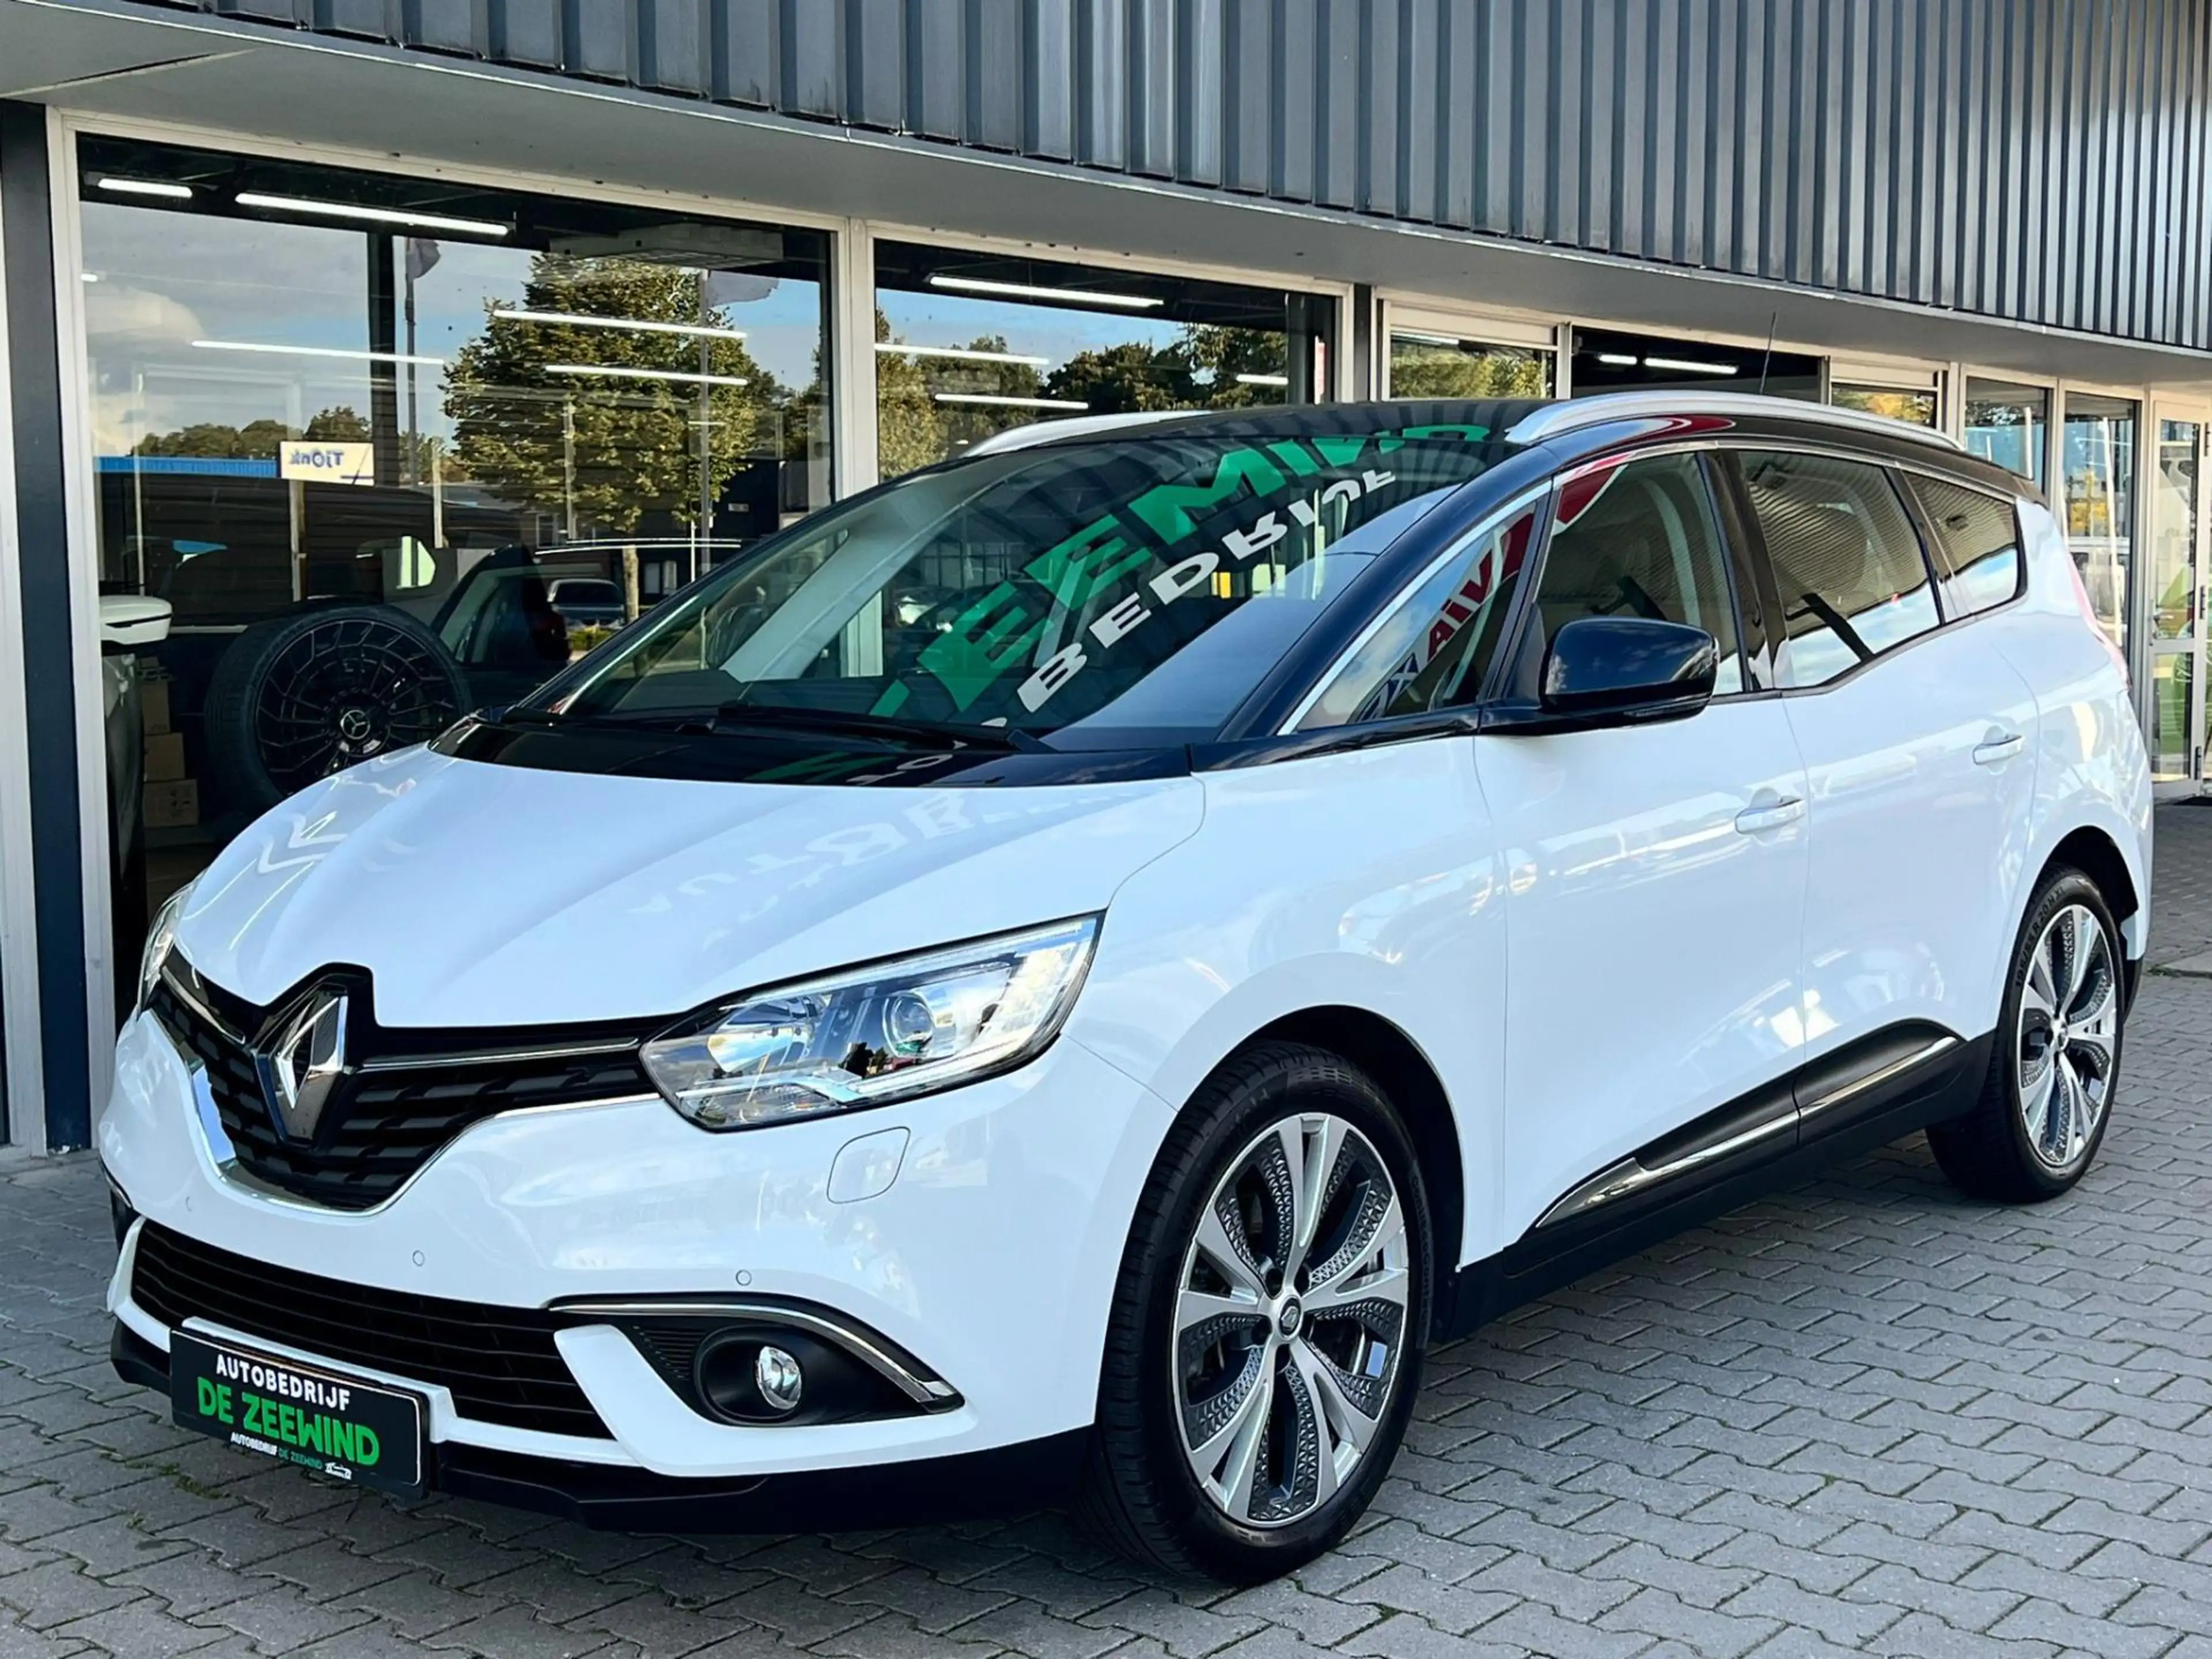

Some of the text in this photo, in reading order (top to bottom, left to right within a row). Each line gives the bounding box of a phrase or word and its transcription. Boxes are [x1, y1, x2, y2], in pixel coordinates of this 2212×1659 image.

[216, 1354, 350, 1411] AUTOBEDRIJF
[198, 1376, 380, 1466] DE ZEEWIND
